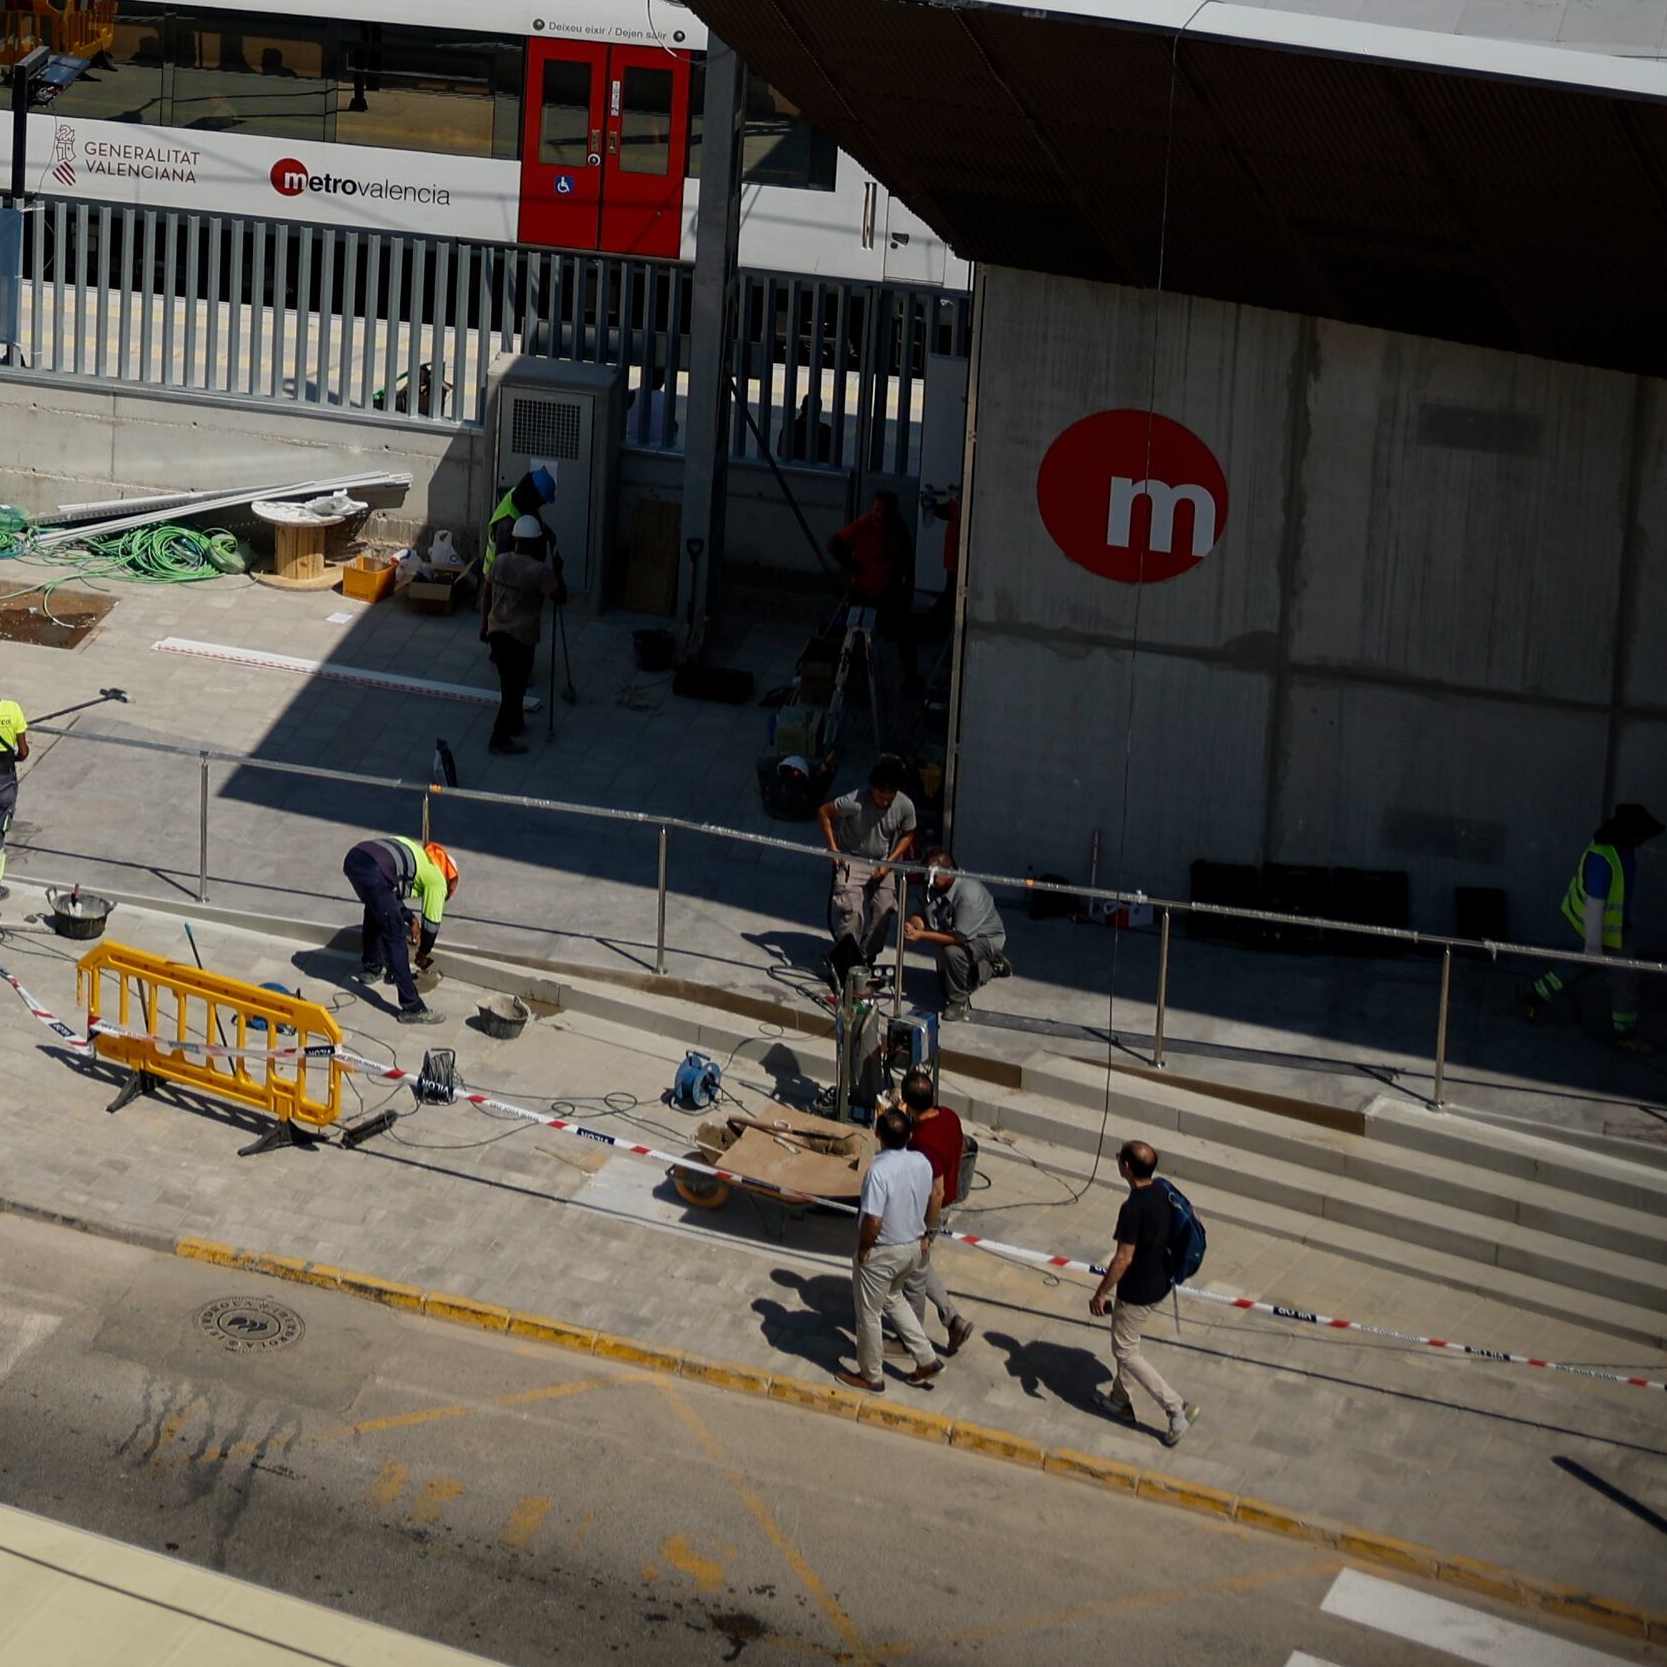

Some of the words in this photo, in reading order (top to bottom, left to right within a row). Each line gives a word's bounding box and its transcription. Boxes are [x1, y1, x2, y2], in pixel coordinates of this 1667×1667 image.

[549, 22, 581, 33] Deixeu
[584, 25, 606, 35] eixir
[615, 27, 643, 39] Dejen
[646, 31, 667, 41] salir
[84, 141, 201, 165] GENERALITAT
[85, 158, 197, 184] VALENCIANA
[284, 170, 451, 205] metrovalencia
[1107, 476, 1216, 557] m
[421, 1078, 450, 1094] VILOR
